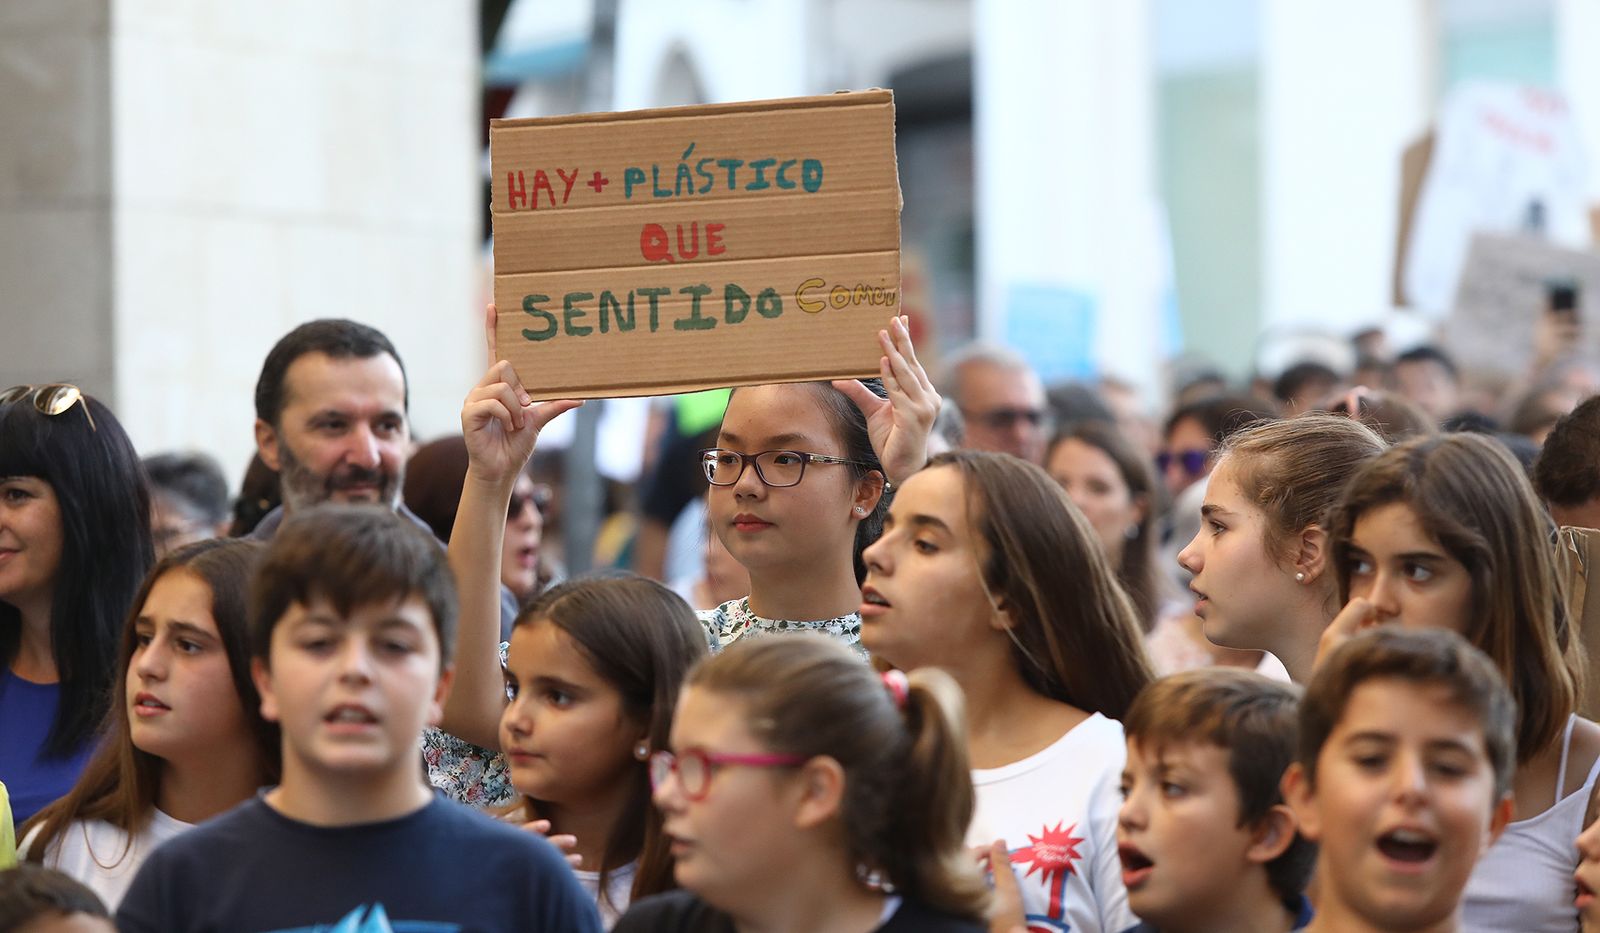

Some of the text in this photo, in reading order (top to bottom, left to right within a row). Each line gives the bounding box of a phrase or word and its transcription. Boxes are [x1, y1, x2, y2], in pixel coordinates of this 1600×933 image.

[507, 142, 824, 210] HAY + PLÁSTICO
[640, 221, 727, 264] QUE
[521, 282, 783, 342] SENTIDO
